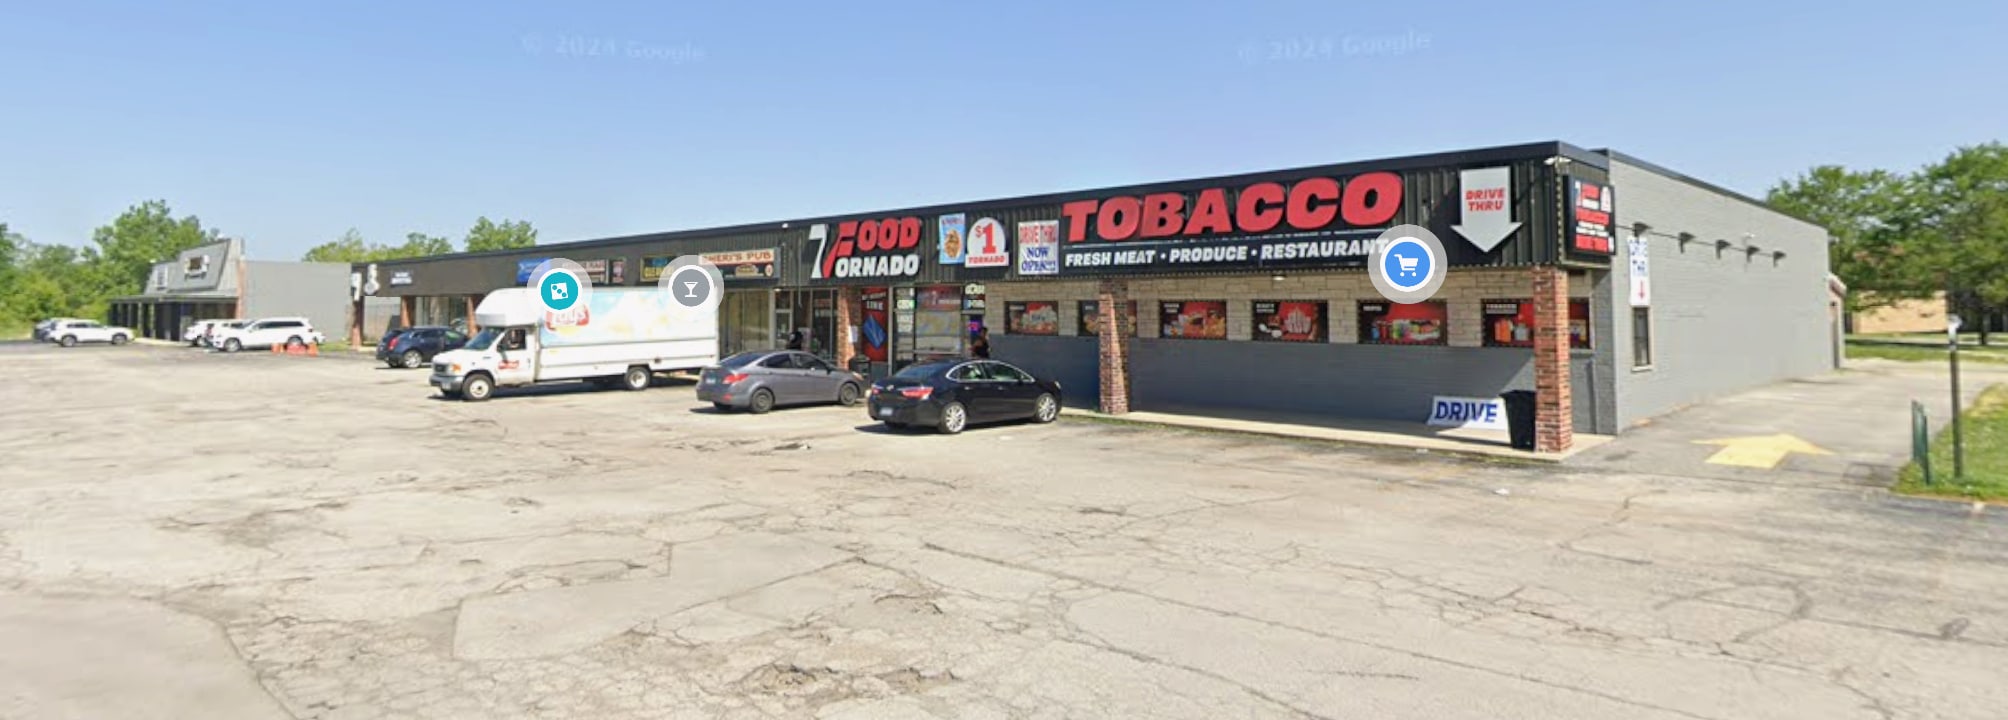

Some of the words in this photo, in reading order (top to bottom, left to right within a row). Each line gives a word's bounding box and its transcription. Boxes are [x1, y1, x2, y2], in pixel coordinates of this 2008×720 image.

[1465, 187, 1505, 200] DRIVE
[1062, 171, 1404, 242] TOBACCO
[1467, 200, 1504, 212] THRU
[823, 216, 921, 278] FOOD
[975, 222, 997, 254] $1
[746, 250, 771, 260] PUB
[968, 255, 1006, 264] TORNADO
[1026, 246, 1050, 258] NOW
[1064, 251, 1111, 268] FRESH
[1113, 249, 1156, 266] MEAT
[1169, 245, 1249, 263] PRODUCE
[1260, 237, 1389, 260] RESTAURANT
[1434, 400, 1497, 423] DRIVE
